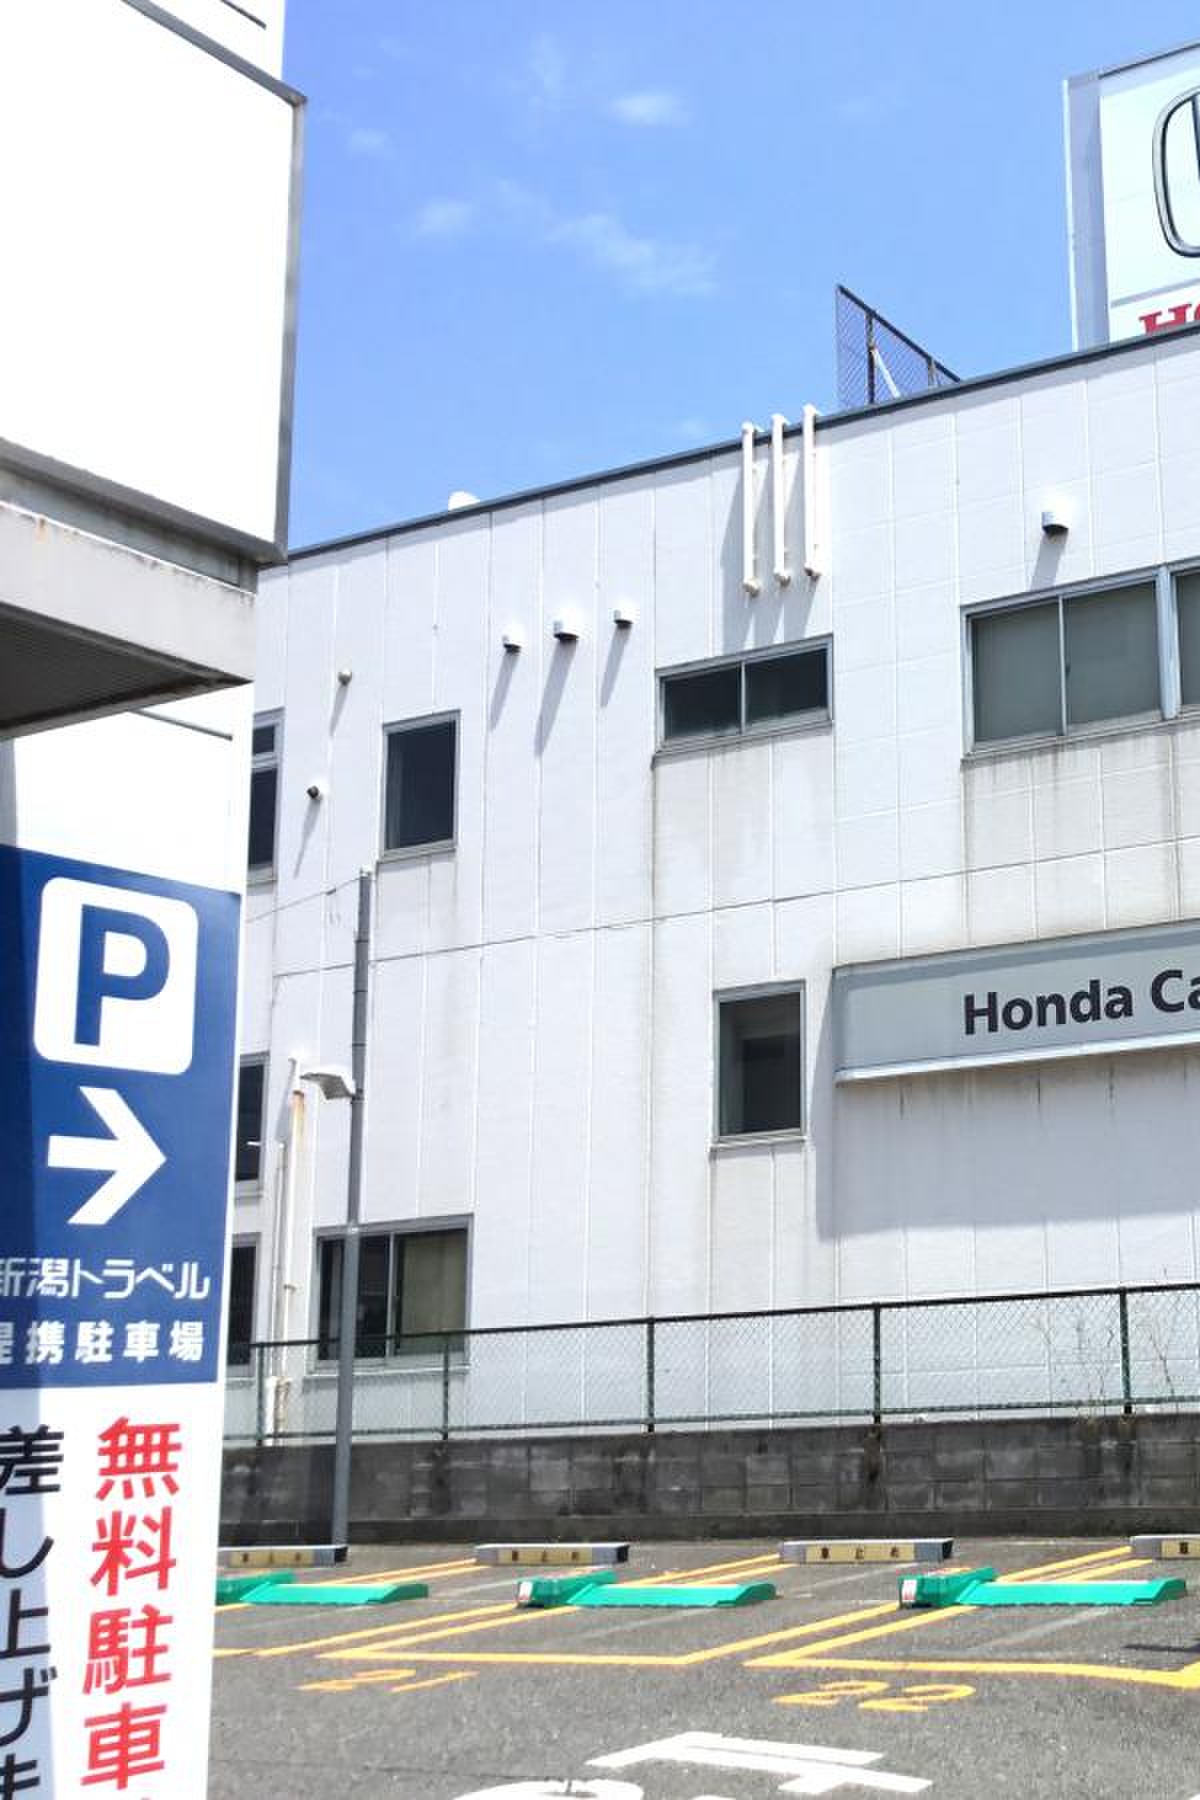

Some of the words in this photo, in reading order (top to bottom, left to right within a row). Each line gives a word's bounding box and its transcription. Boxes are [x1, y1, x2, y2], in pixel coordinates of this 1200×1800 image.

[73, 903, 170, 1047] P
[963, 979, 1134, 1036] Honda
[81, 1416, 182, 1800] 無料駐車
